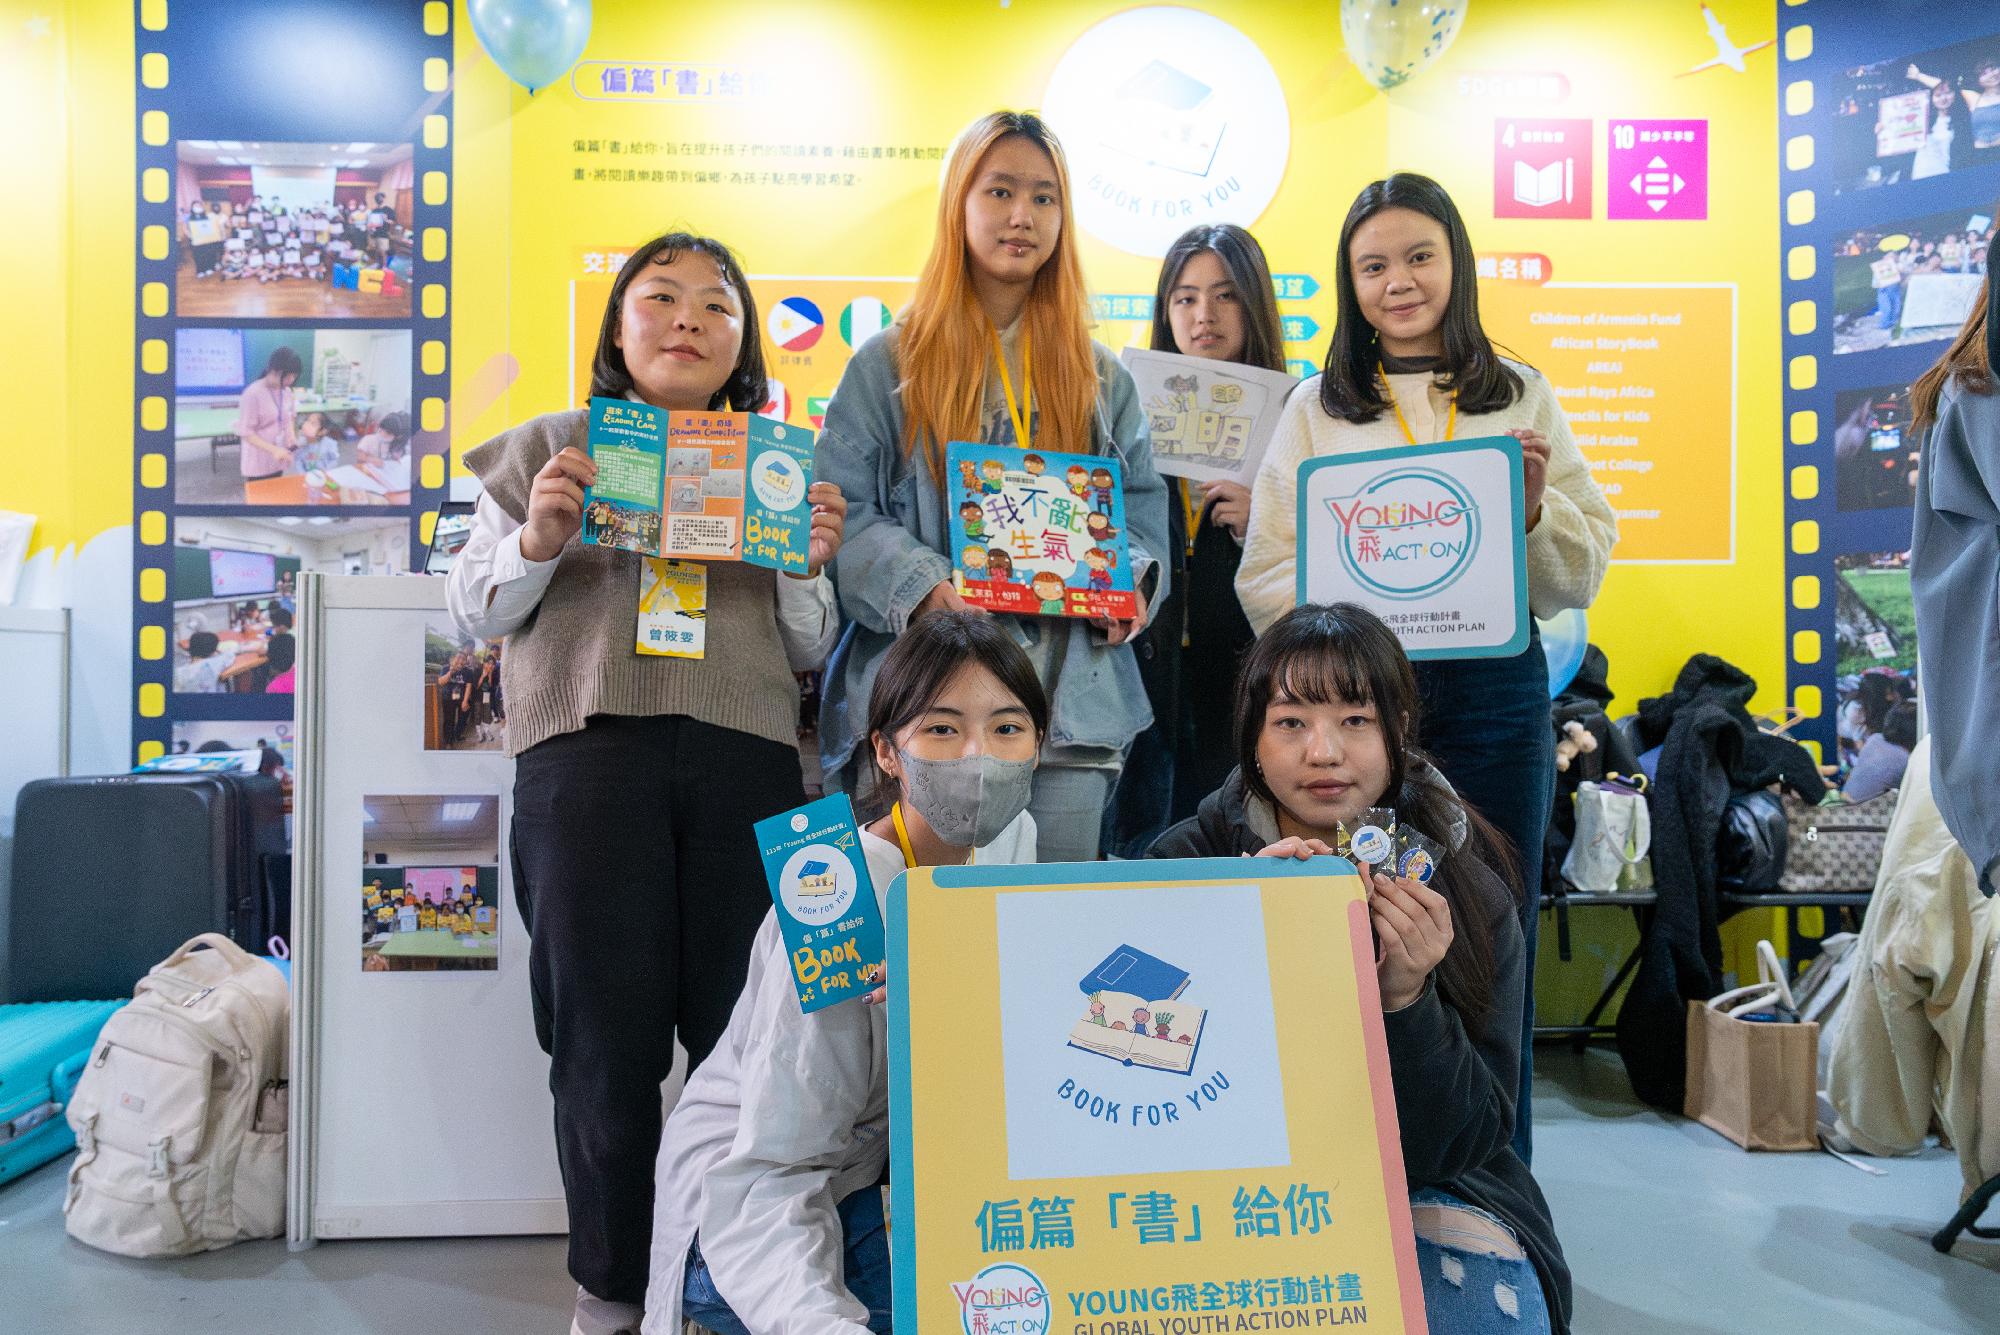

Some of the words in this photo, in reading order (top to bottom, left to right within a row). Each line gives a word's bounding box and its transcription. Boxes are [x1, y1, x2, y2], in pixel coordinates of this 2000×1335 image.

[1501, 123, 1515, 148] 4
[1612, 124, 1635, 149] 10
[1088, 174, 1142, 214] BOOK
[1152, 199, 1193, 218] FOR
[1201, 175, 1241, 209] YOU
[1530, 313, 1581, 326] Children
[1583, 313, 1597, 325] of
[1651, 313, 1682, 326] Fund
[1551, 337, 1593, 350] African
[1619, 386, 1655, 398] Africa
[1566, 411, 1601, 422] encils
[1603, 411, 1620, 422] for
[1010, 528, 1076, 564] 生氣
[1381, 610, 1461, 625] G飛全球行動計畫
[1391, 625, 1414, 636] UTH
[1415, 623, 1455, 635] ACTION
[1457, 622, 1486, 633] PLAN
[797, 904, 818, 916] BOOK
[820, 903, 835, 914] FOR
[835, 889, 849, 905] YOU
[820, 971, 851, 995] FOR
[1057, 1078, 1121, 1124] BOOK
[1132, 1101, 1179, 1127] FOR
[1185, 1070, 1230, 1112] YOU
[1158, 1314, 1230, 1335] YOUTH
[1234, 1309, 1310, 1332] ACTION
[1316, 1305, 1368, 1327] PLAN
